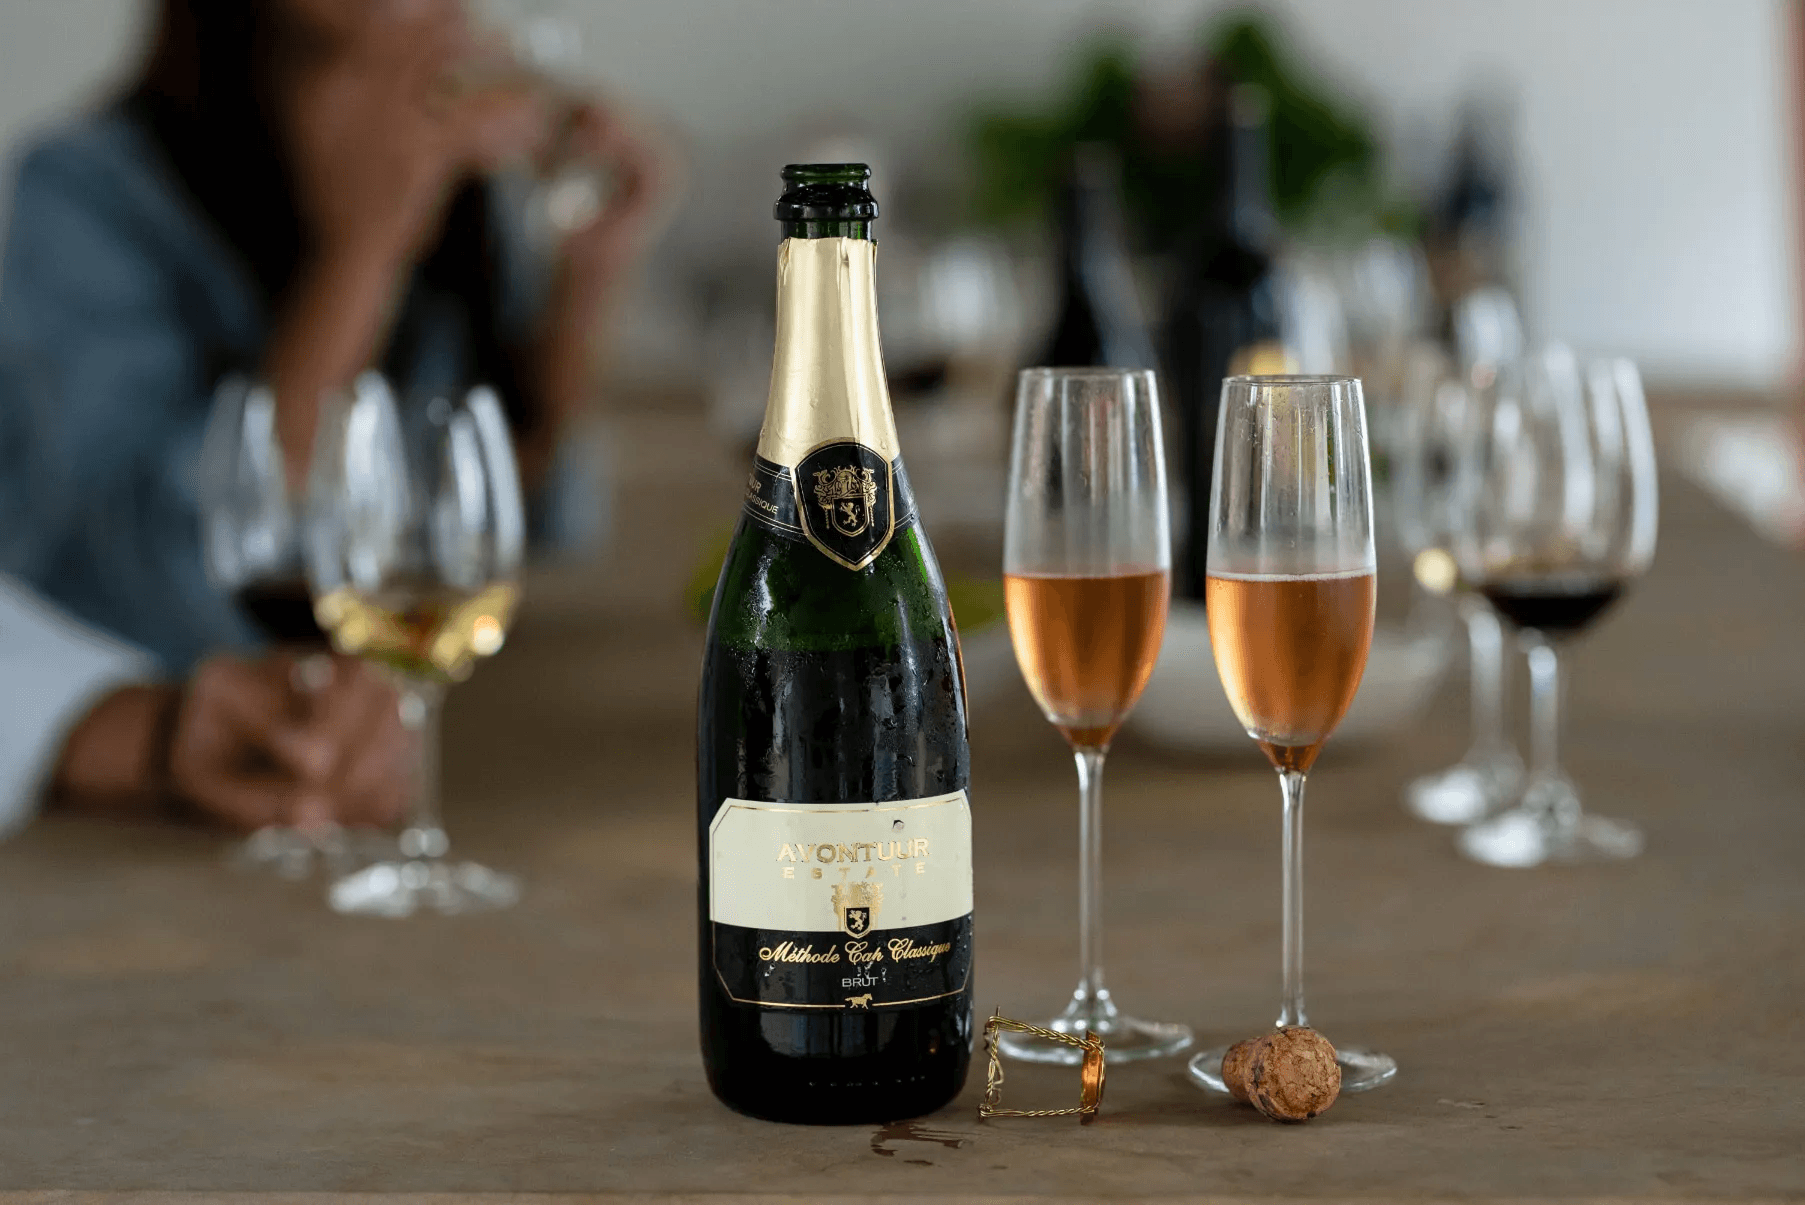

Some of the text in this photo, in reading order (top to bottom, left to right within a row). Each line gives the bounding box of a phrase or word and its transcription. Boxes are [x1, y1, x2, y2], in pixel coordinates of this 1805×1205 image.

[776, 838, 930, 864] AVONTUUR
[782, 861, 926, 879] ESTATE
[759, 941, 840, 963] Méthode
[887, 938, 951, 963] Classique
[841, 977, 879, 988] BRUT
